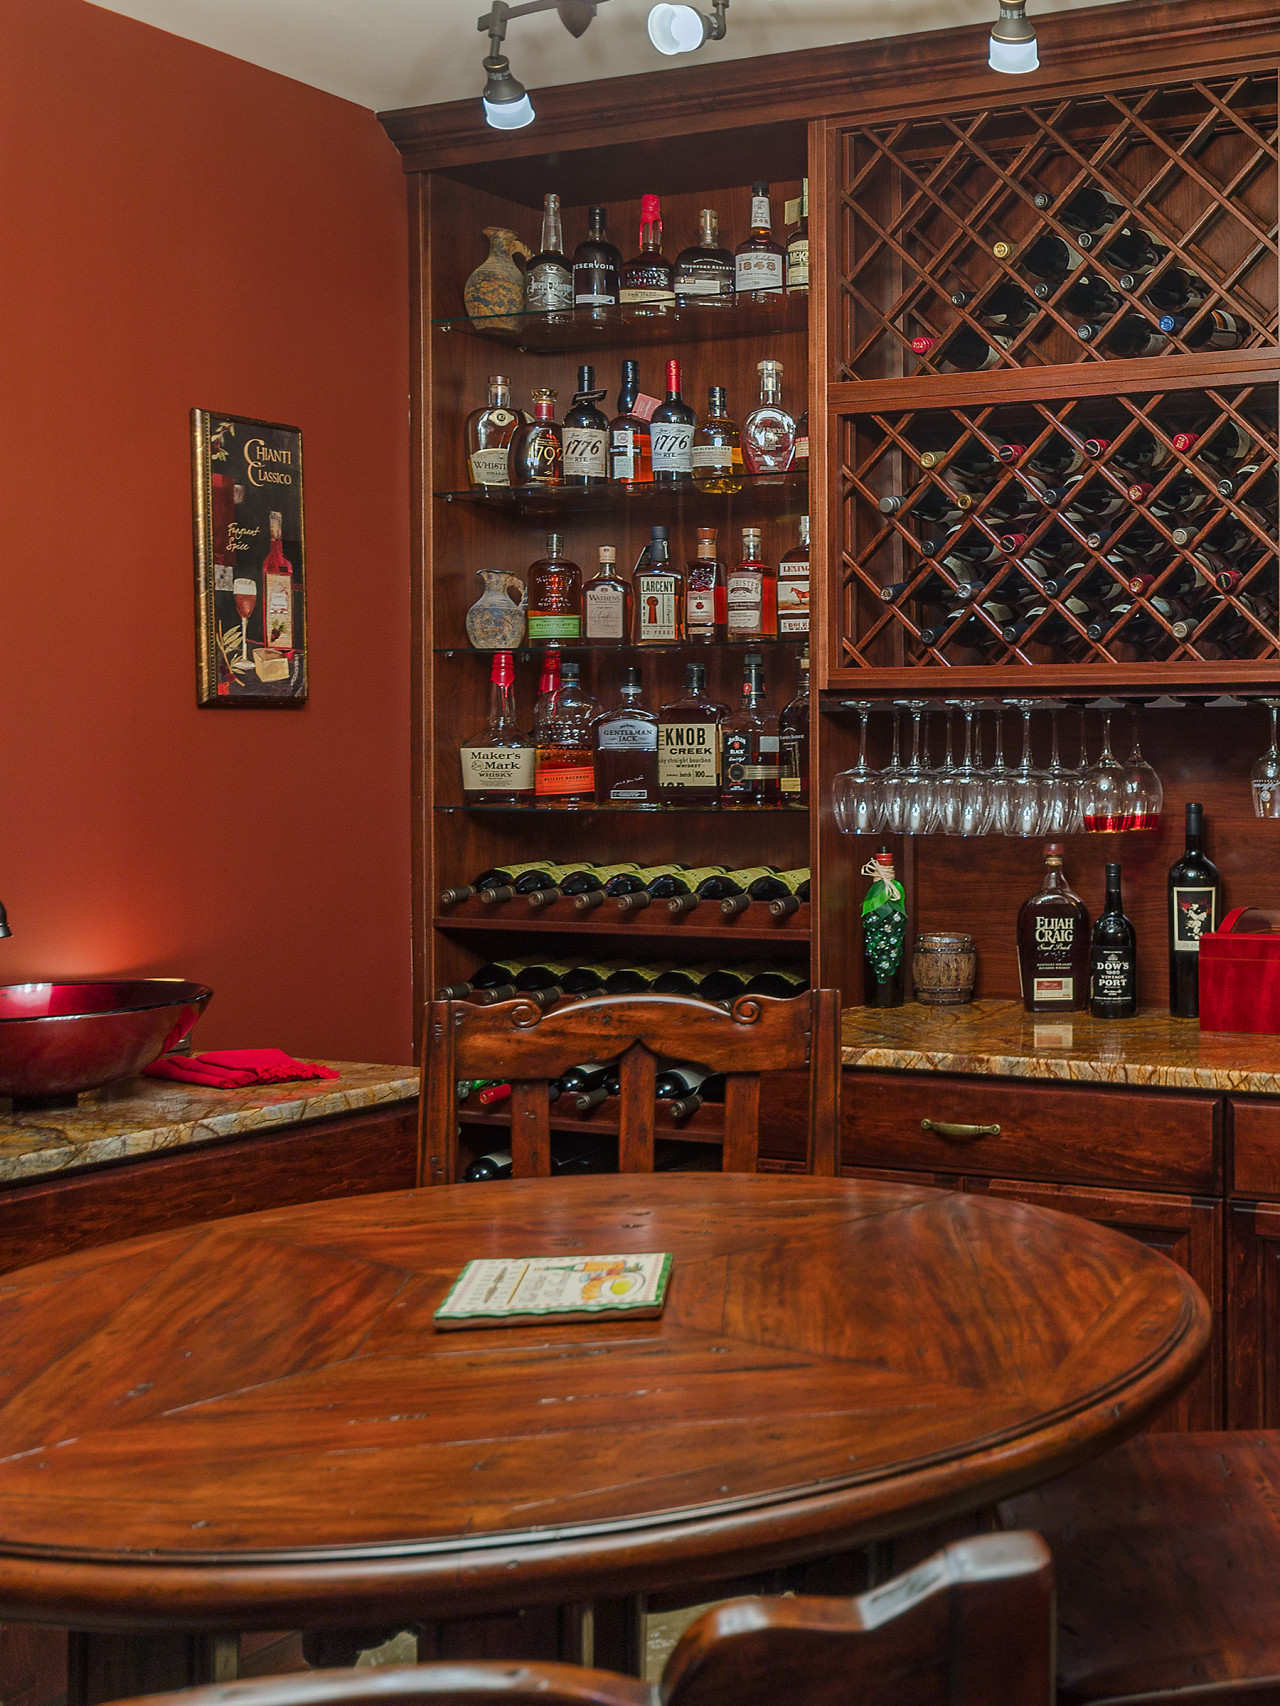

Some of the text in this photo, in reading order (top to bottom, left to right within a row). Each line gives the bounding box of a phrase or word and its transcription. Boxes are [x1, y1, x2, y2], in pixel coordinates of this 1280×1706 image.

[565, 439, 602, 456] 1776
[653, 434, 690, 452] 1776
[243, 438, 292, 468] CHIANTI
[247, 460, 292, 487] CLASSICO
[641, 581, 674, 593] LARCENY
[665, 727, 706, 746] KNOB
[470, 752, 521, 760] Maker's
[670, 747, 713, 755] CREEK
[485, 762, 522, 770] Mark
[1035, 916, 1075, 930] ELIJAH
[1035, 929, 1075, 944] CRAIG
[1096, 962, 1130, 970] DOW'S
